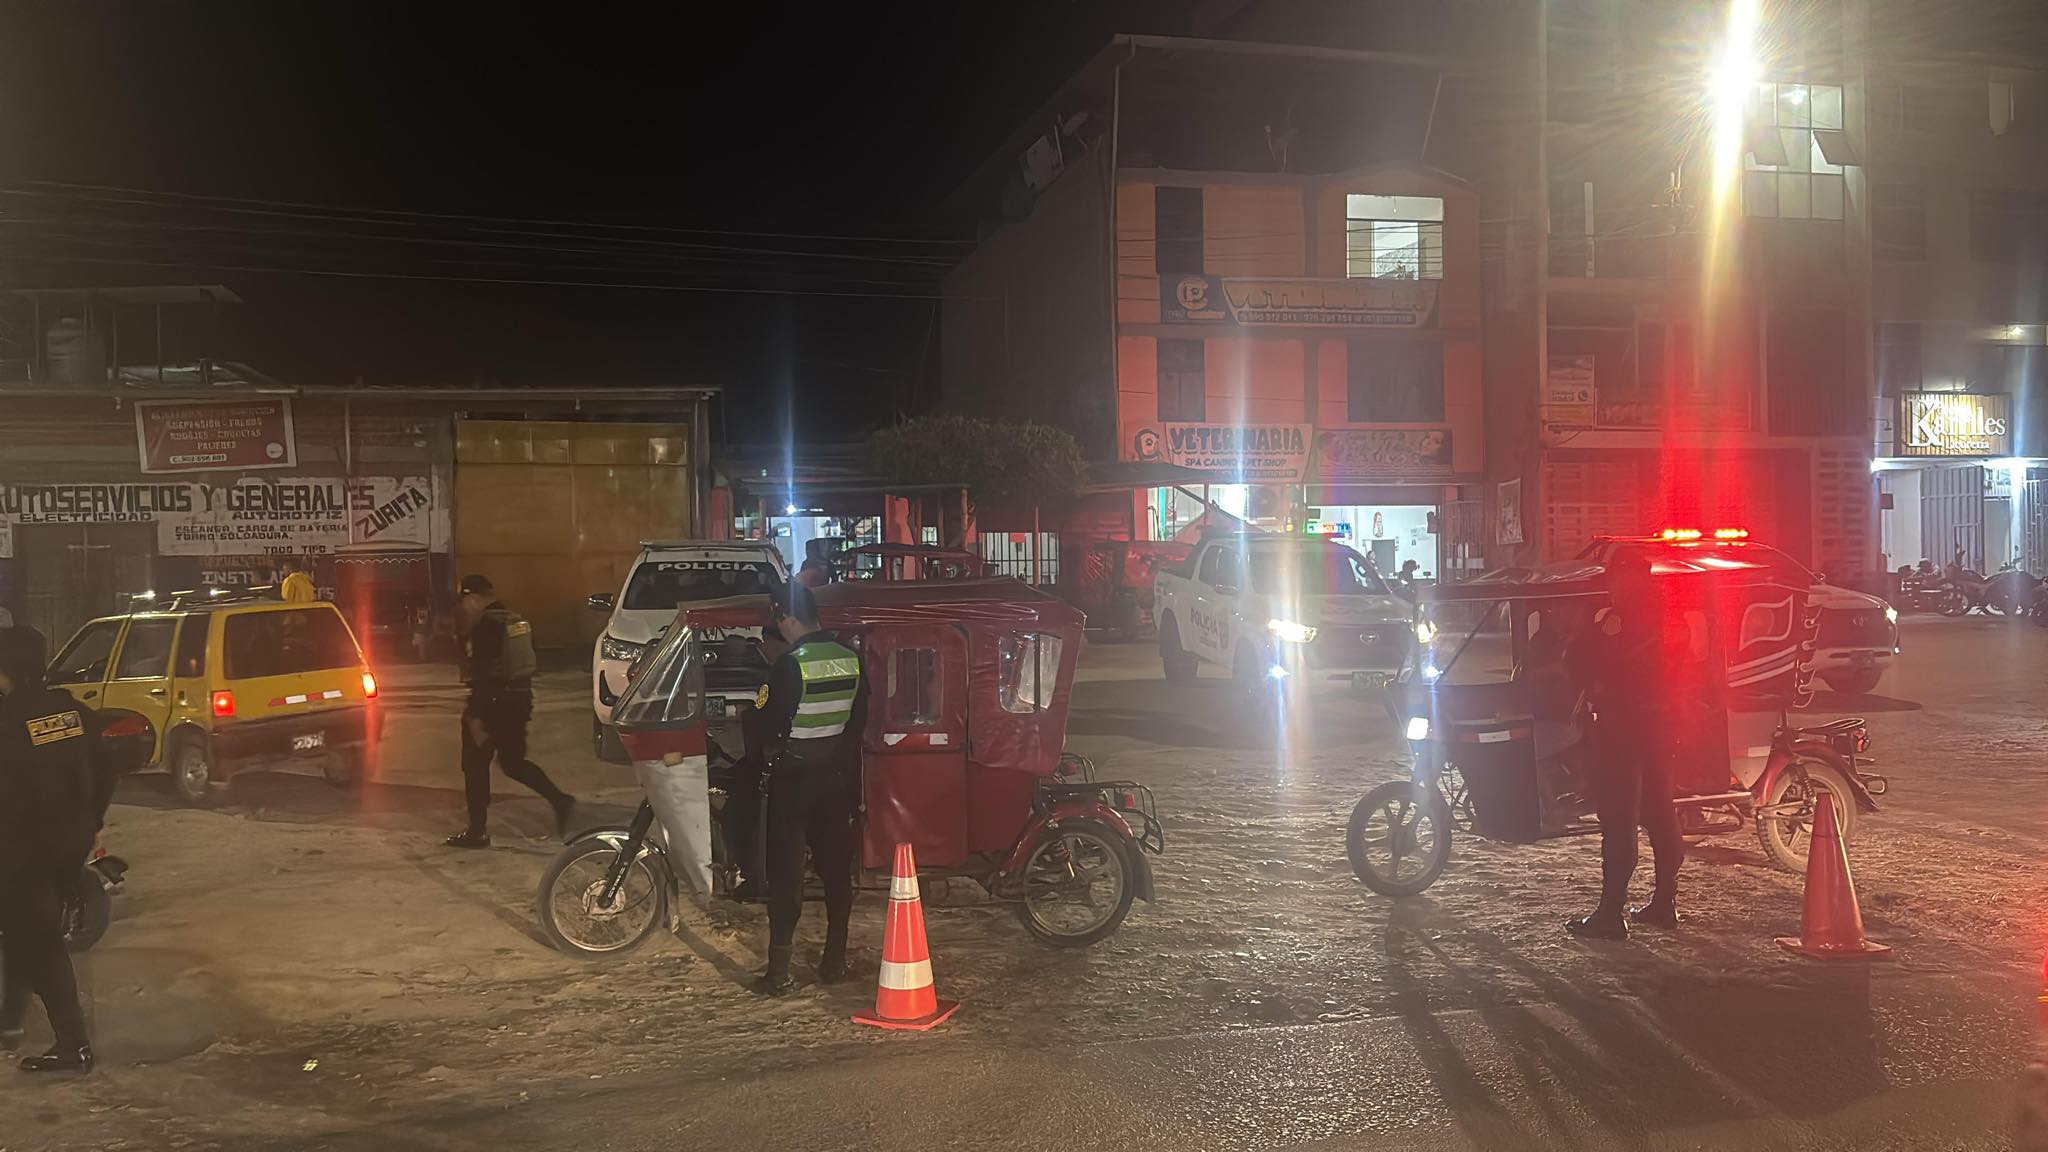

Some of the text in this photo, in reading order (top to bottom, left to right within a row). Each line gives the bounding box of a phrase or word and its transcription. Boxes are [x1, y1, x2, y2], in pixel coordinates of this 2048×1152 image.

[1184, 458, 1202, 467] SPA
[200, 485, 217, 512] Y
[226, 484, 375, 511] GENERALES
[20, 510, 343, 522] ELECTRICIDAD AUTOMOTRIZ
[355, 487, 428, 539] ZURITA
[237, 524, 275, 533] CARGA
[280, 524, 295, 532] DE
[263, 545, 326, 554] TODO TIPO
[657, 562, 760, 572] POLICIA
